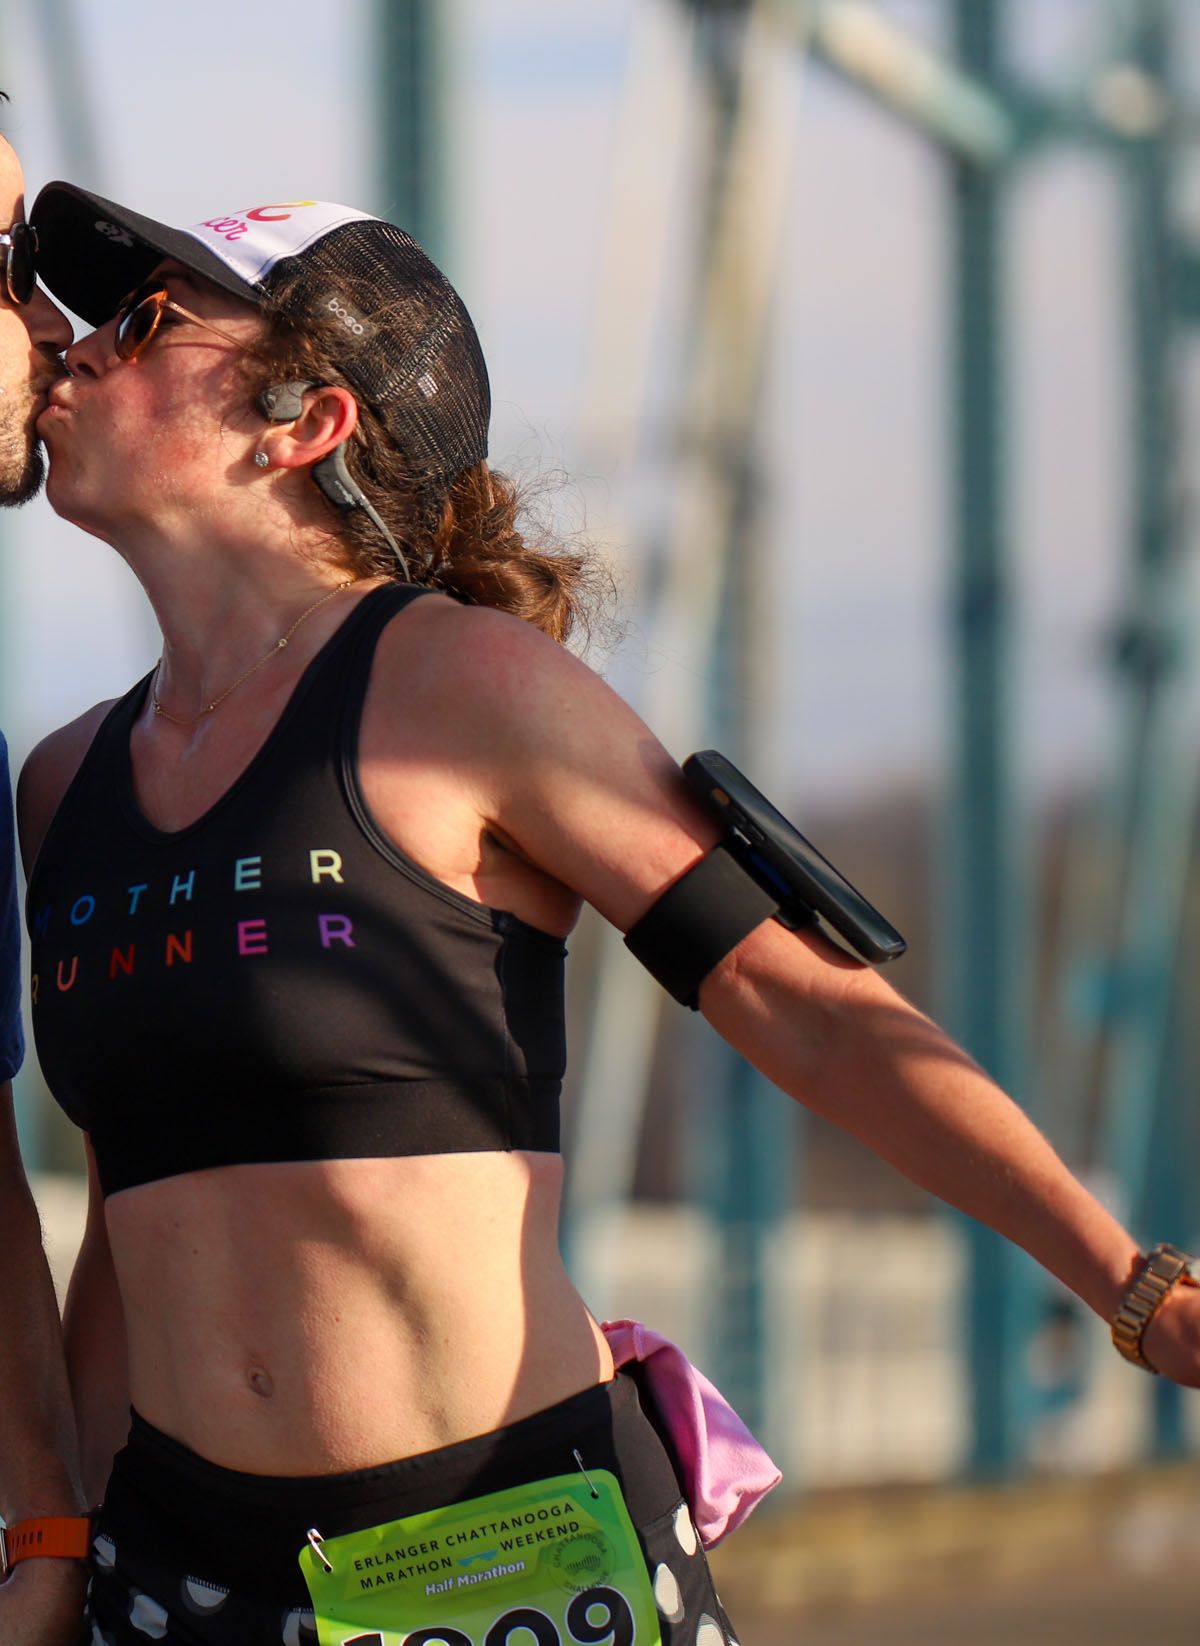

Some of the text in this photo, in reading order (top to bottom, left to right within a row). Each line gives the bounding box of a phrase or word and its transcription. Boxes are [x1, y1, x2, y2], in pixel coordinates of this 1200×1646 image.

[328, 297, 364, 335] boco
[34, 849, 344, 938] MOTHER
[354, 1502, 575, 1571] ERLANGER CHATTANOOGA
[360, 1521, 580, 1590] MARATHON WEEKEND
[424, 1560, 526, 1597] Half Marathon
